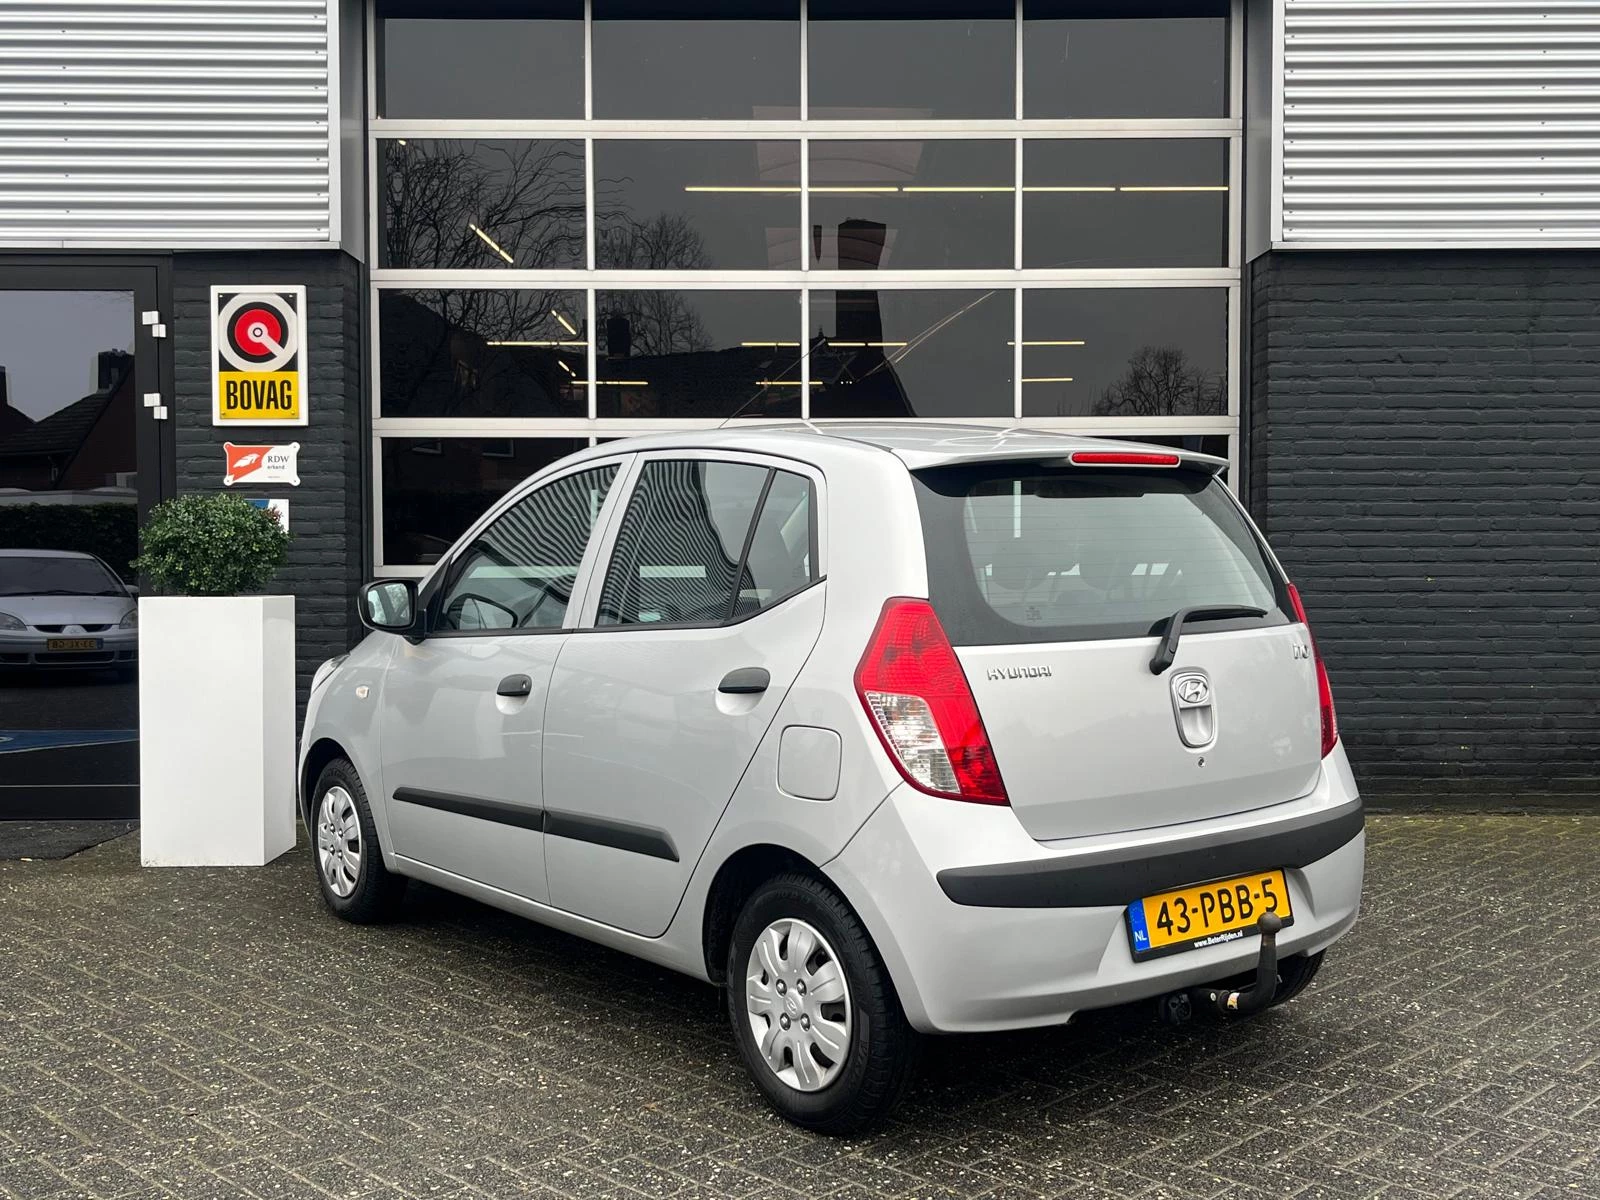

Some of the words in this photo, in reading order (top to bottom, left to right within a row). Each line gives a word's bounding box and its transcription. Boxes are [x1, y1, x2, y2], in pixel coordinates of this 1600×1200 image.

[226, 379, 292, 410] BOVAG
[267, 455, 290, 463] RDW
[986, 666, 1052, 681] HYUNDAI
[1156, 878, 1278, 936] 43-PBB-5
[1134, 930, 1148, 942] NL
[1193, 930, 1243, 947] www.BeterRijden.nl
